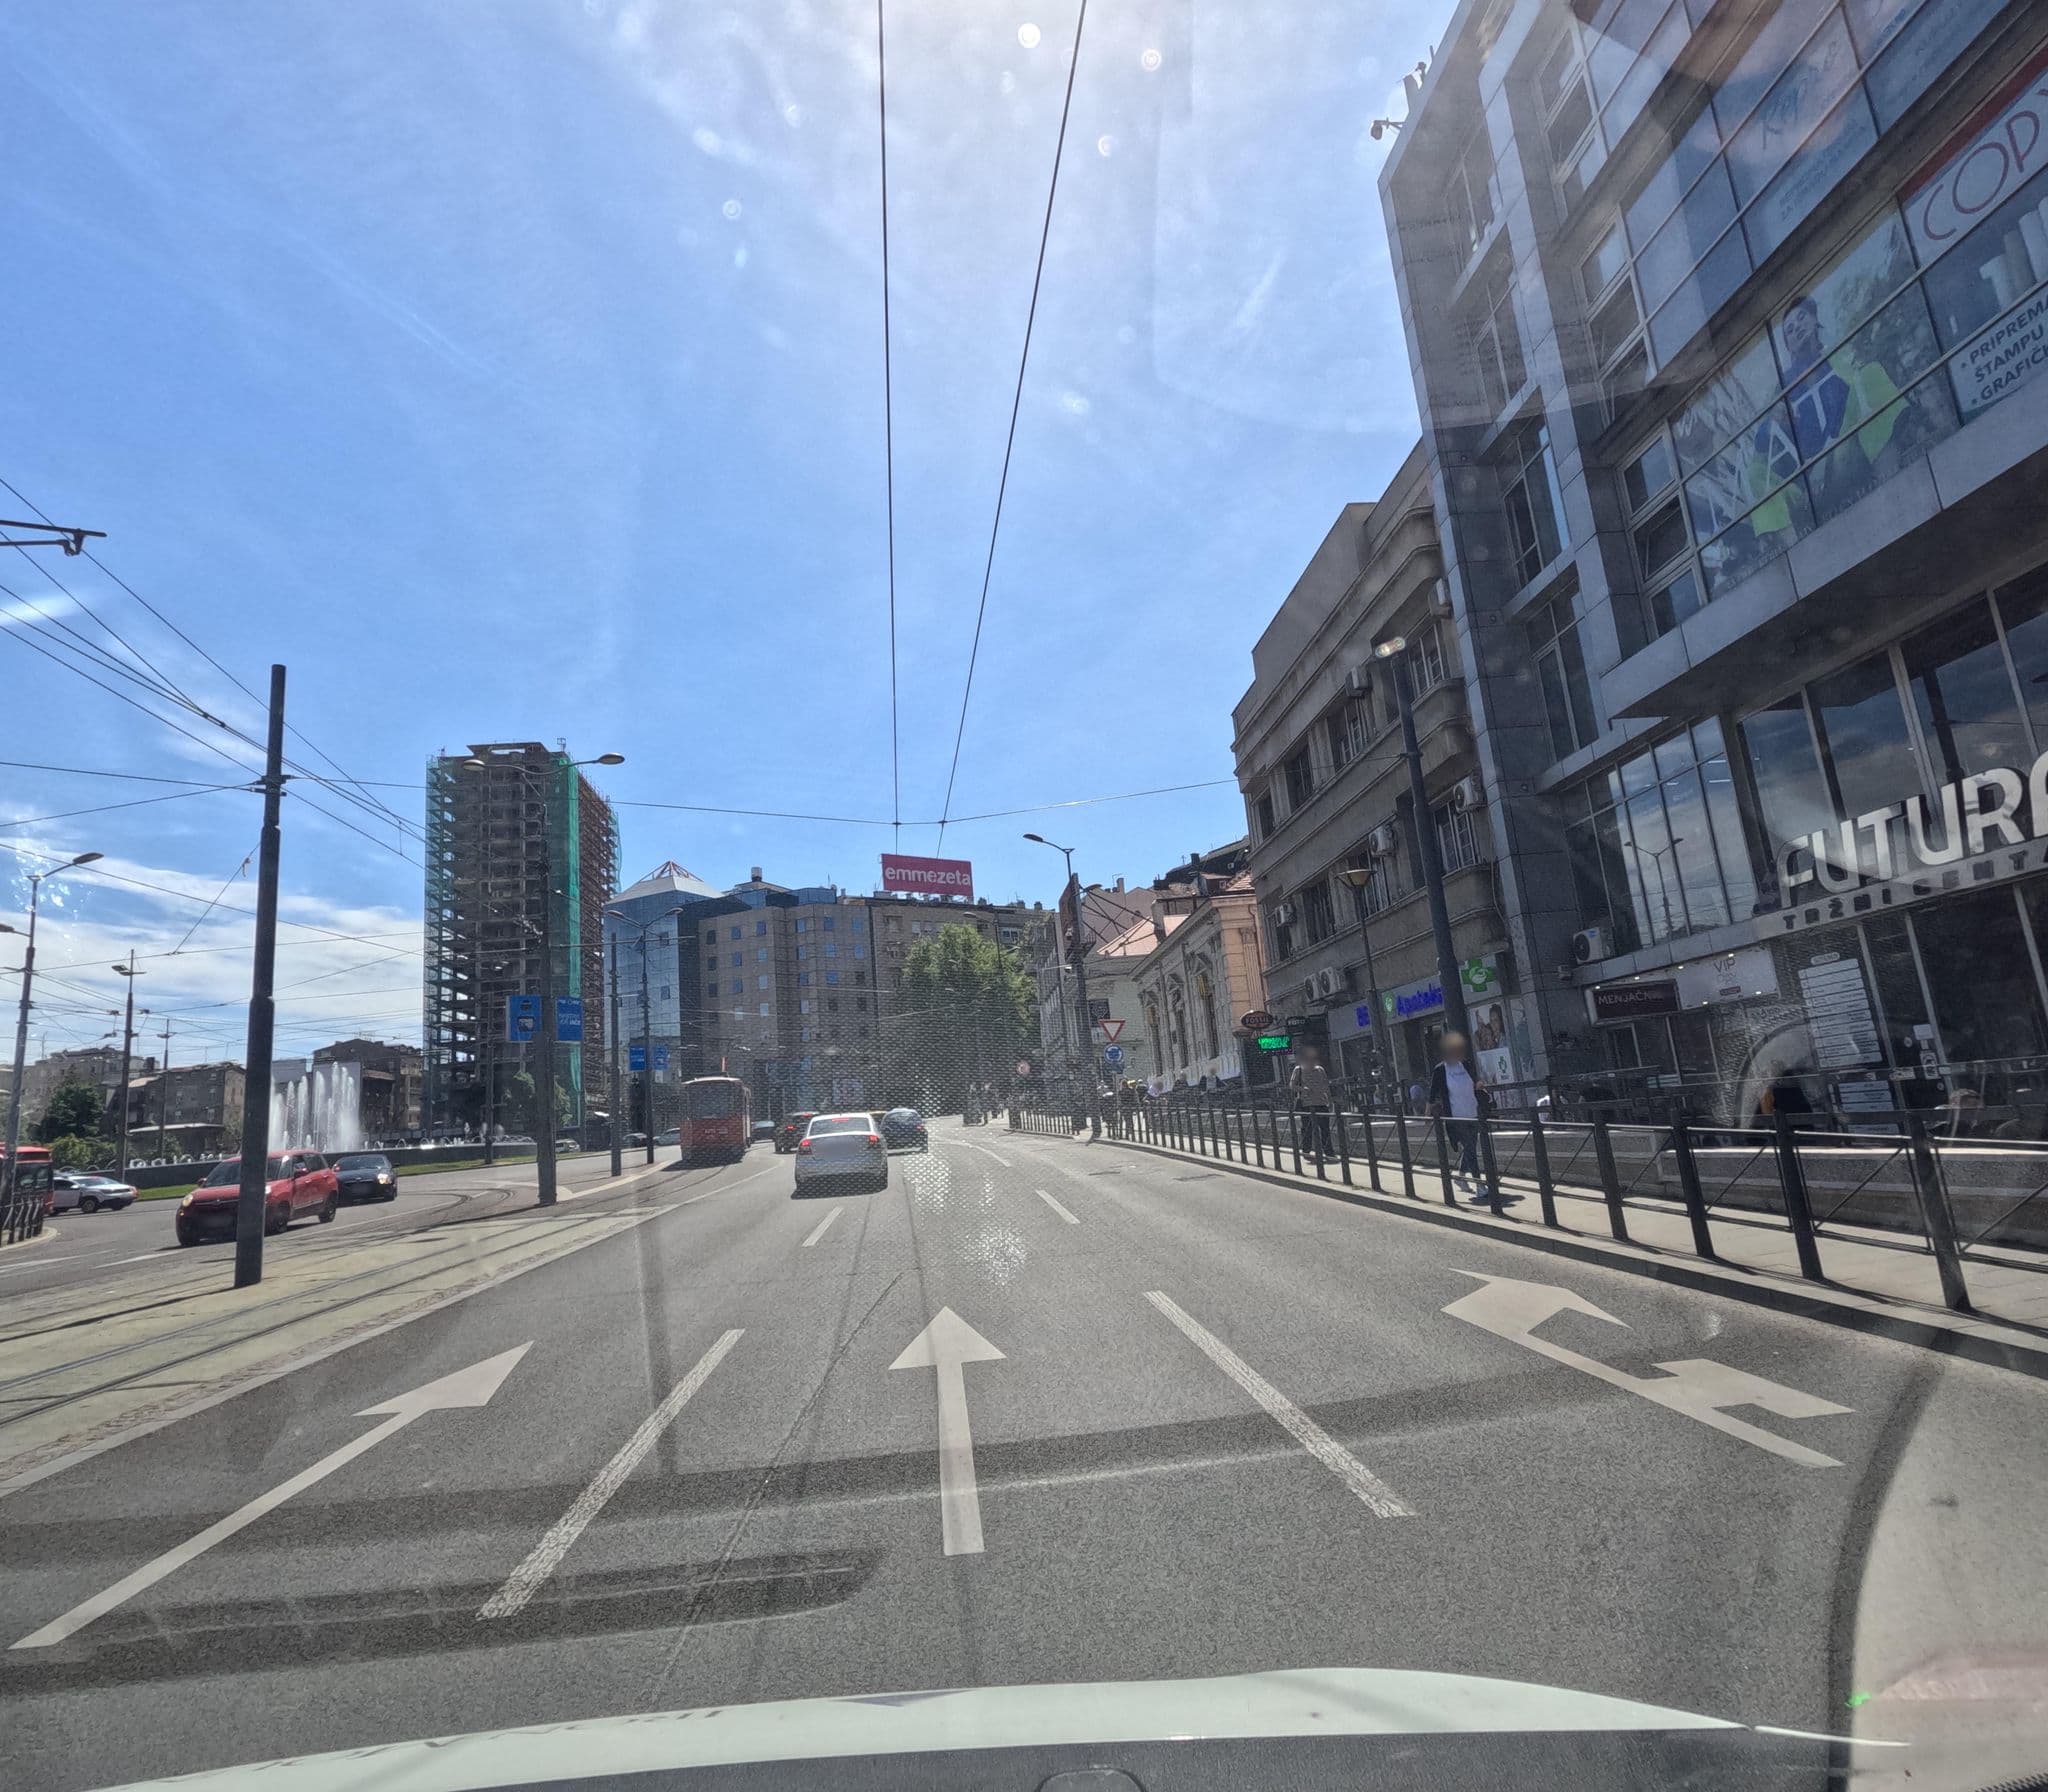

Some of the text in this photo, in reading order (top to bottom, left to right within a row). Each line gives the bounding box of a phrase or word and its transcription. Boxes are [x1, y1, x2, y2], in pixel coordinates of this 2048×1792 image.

[1924, 88, 2048, 240] COP
[1974, 324, 2044, 383] ŠTAMPU
[884, 866, 971, 886] emmezeta
[1913, 846, 2048, 897] CENT
[1713, 958, 1736, 973] VIP
